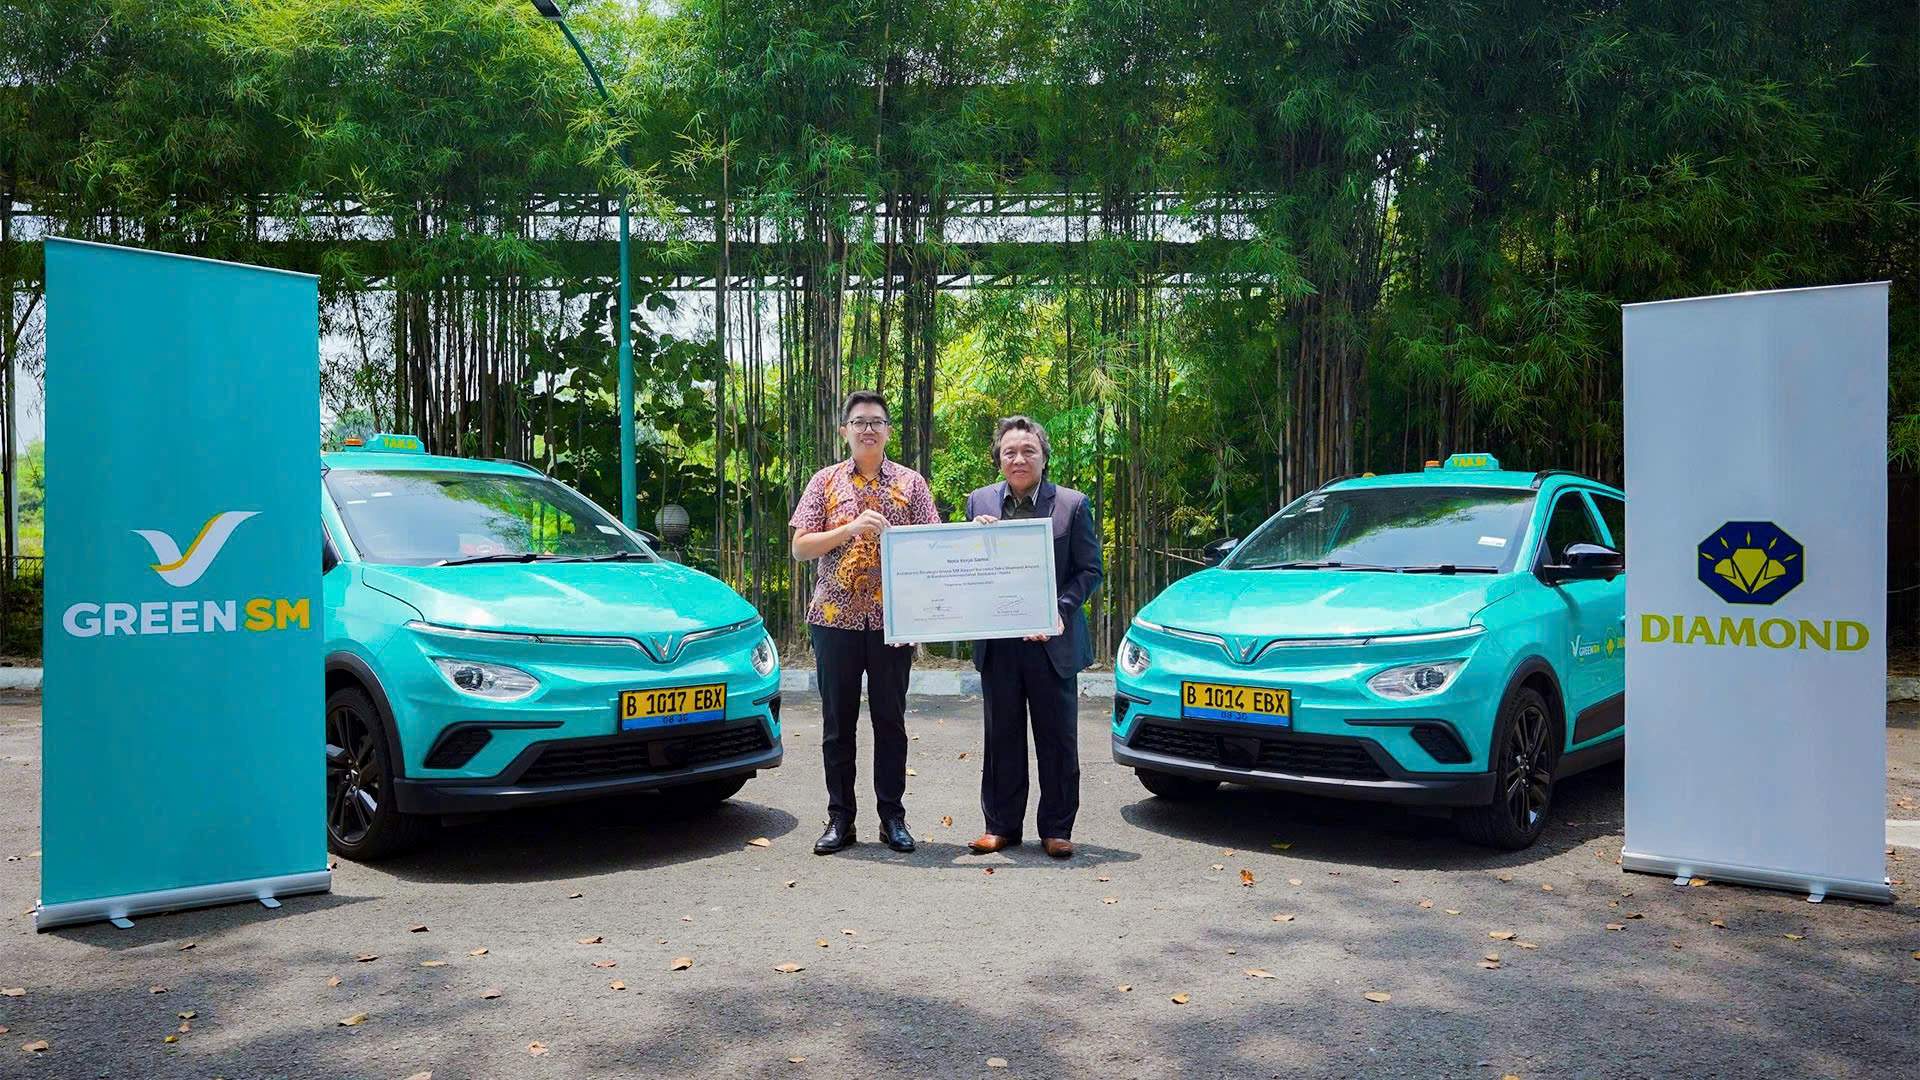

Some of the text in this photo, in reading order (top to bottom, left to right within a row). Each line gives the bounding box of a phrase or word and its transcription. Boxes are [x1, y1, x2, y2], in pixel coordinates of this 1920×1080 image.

[62, 598, 311, 638] GREEN SM
[1640, 614, 1870, 651] DIAMOND
[626, 688, 722, 716] B 1017 EBX
[1187, 685, 1285, 714] B 1014 EBX
